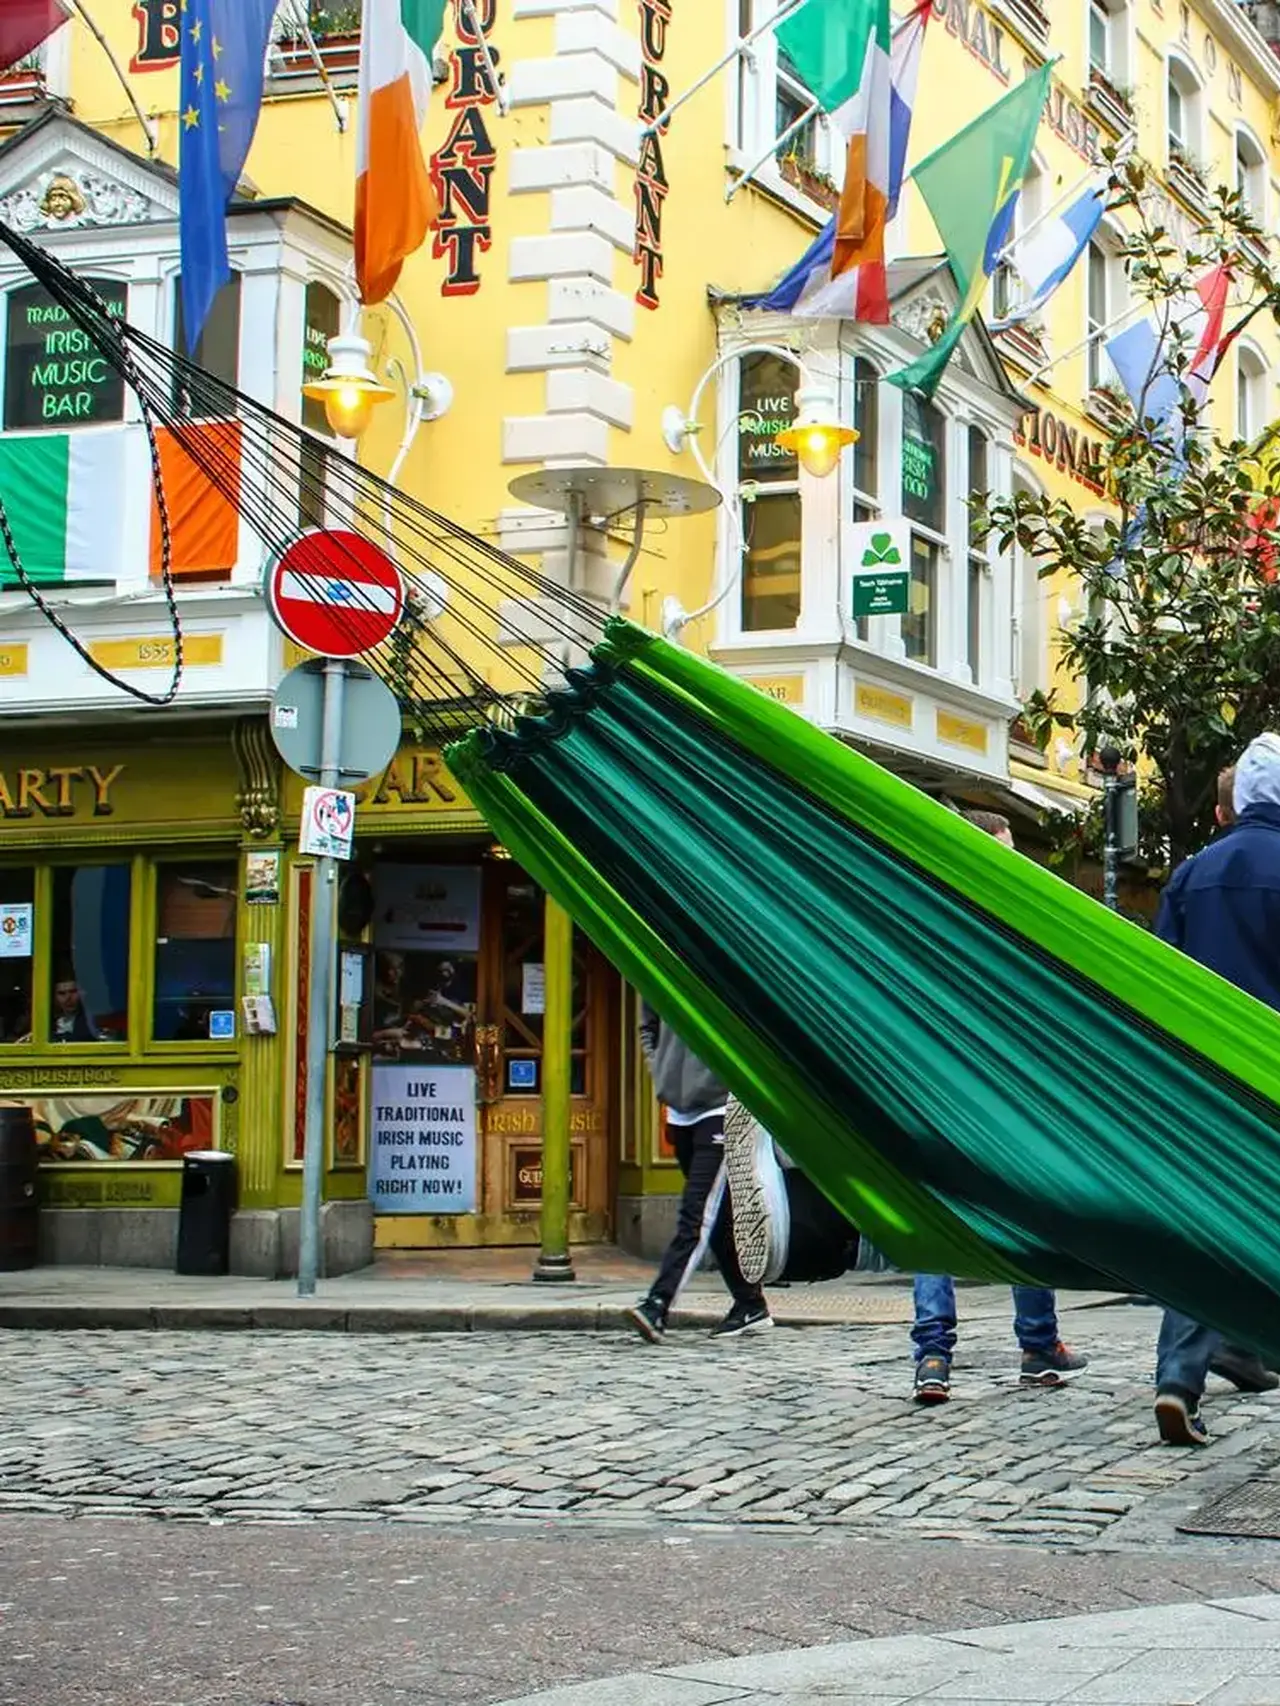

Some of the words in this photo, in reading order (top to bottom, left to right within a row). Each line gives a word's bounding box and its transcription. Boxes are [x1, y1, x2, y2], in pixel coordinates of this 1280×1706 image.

[634, 0, 672, 311] URANT
[32, 359, 108, 386] MUSIC
[42, 392, 91, 418] BAR
[757, 396, 790, 412] LIVE
[355, 751, 456, 804] AR
[407, 1082, 436, 1098] LIVE
[375, 1106, 465, 1122] TRADITIONAL
[378, 1130, 415, 1146] IRISH
[419, 1130, 464, 1146] MUSIC
[390, 1155, 450, 1170] PLAYING
[375, 1179, 416, 1194] RIGHT
[422, 1179, 462, 1194] NOW!
